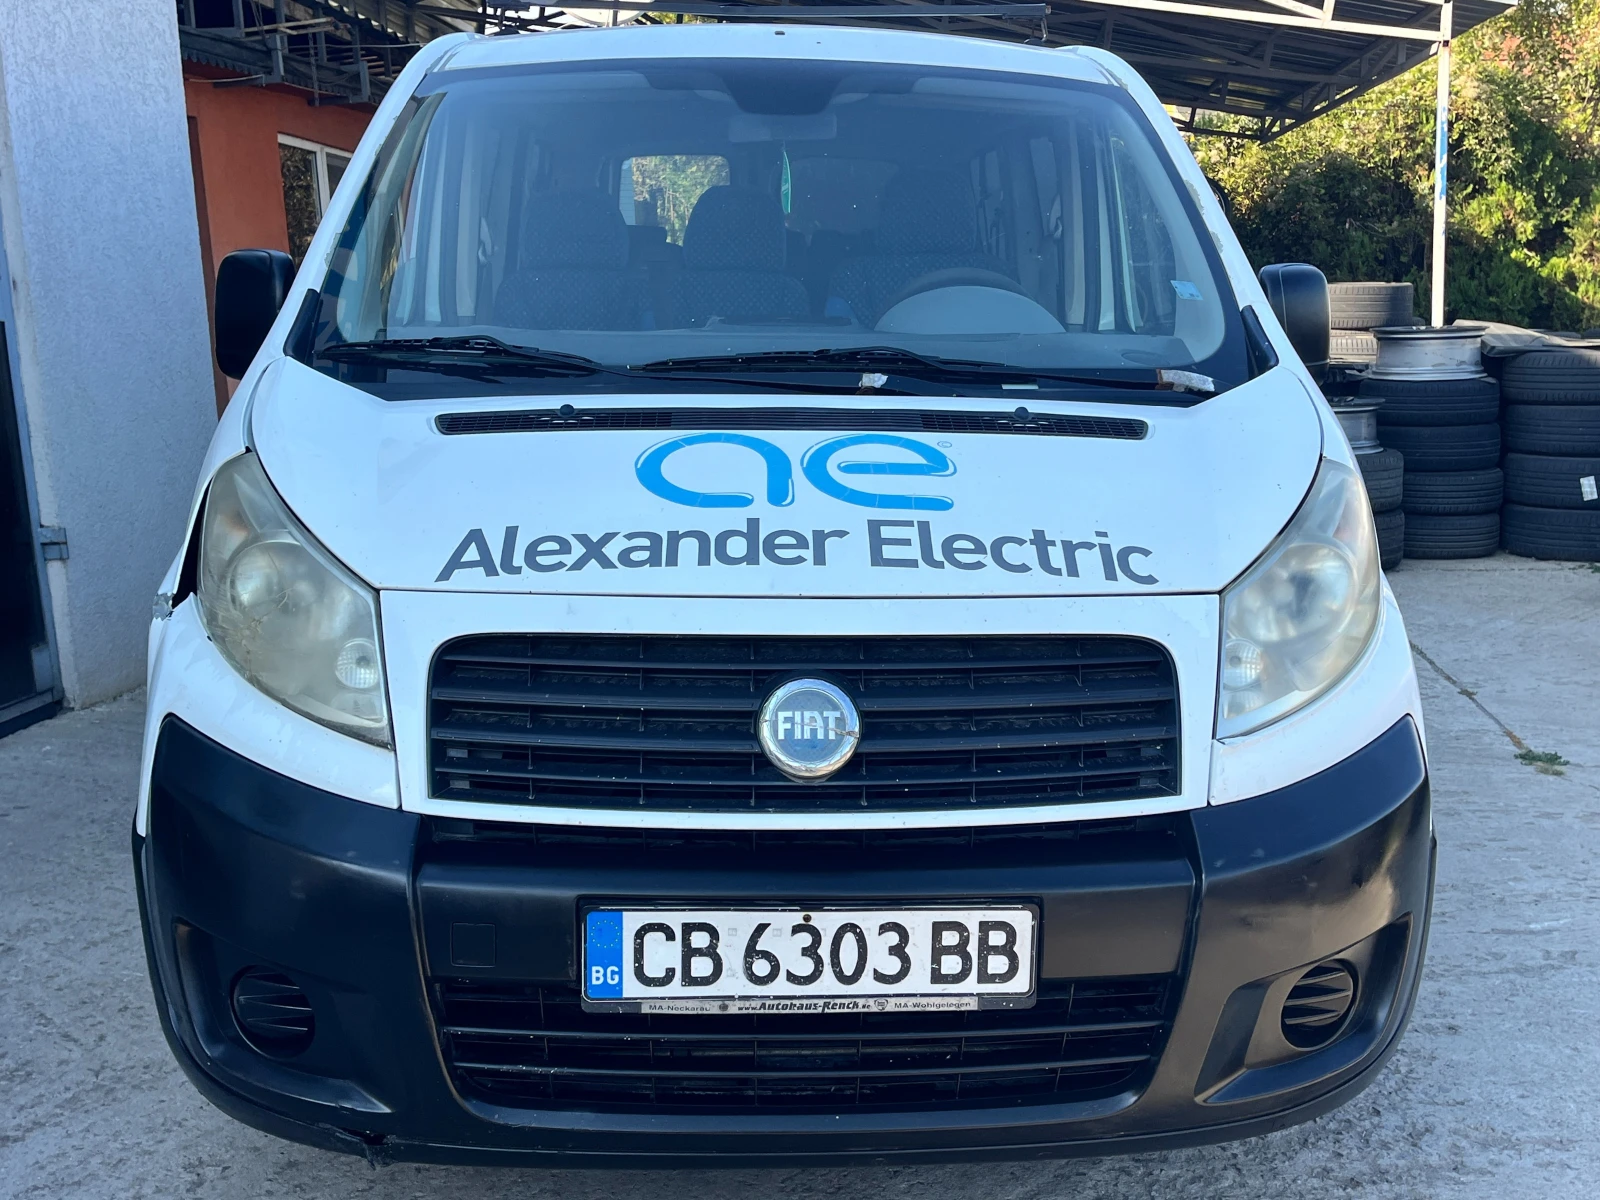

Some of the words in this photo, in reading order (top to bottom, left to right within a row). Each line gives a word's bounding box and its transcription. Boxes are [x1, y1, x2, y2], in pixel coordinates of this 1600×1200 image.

[434, 517, 850, 583] Alexander
[867, 518, 1160, 586] Electric
[777, 710, 841, 740] FIAT
[633, 922, 725, 987] CB
[742, 922, 912, 986] 6303
[930, 920, 1020, 985] BB
[591, 965, 620, 985] BG
[648, 1004, 711, 1012] MA-Neckarau
[894, 1001, 971, 1010] MA-Wohlgelegen
